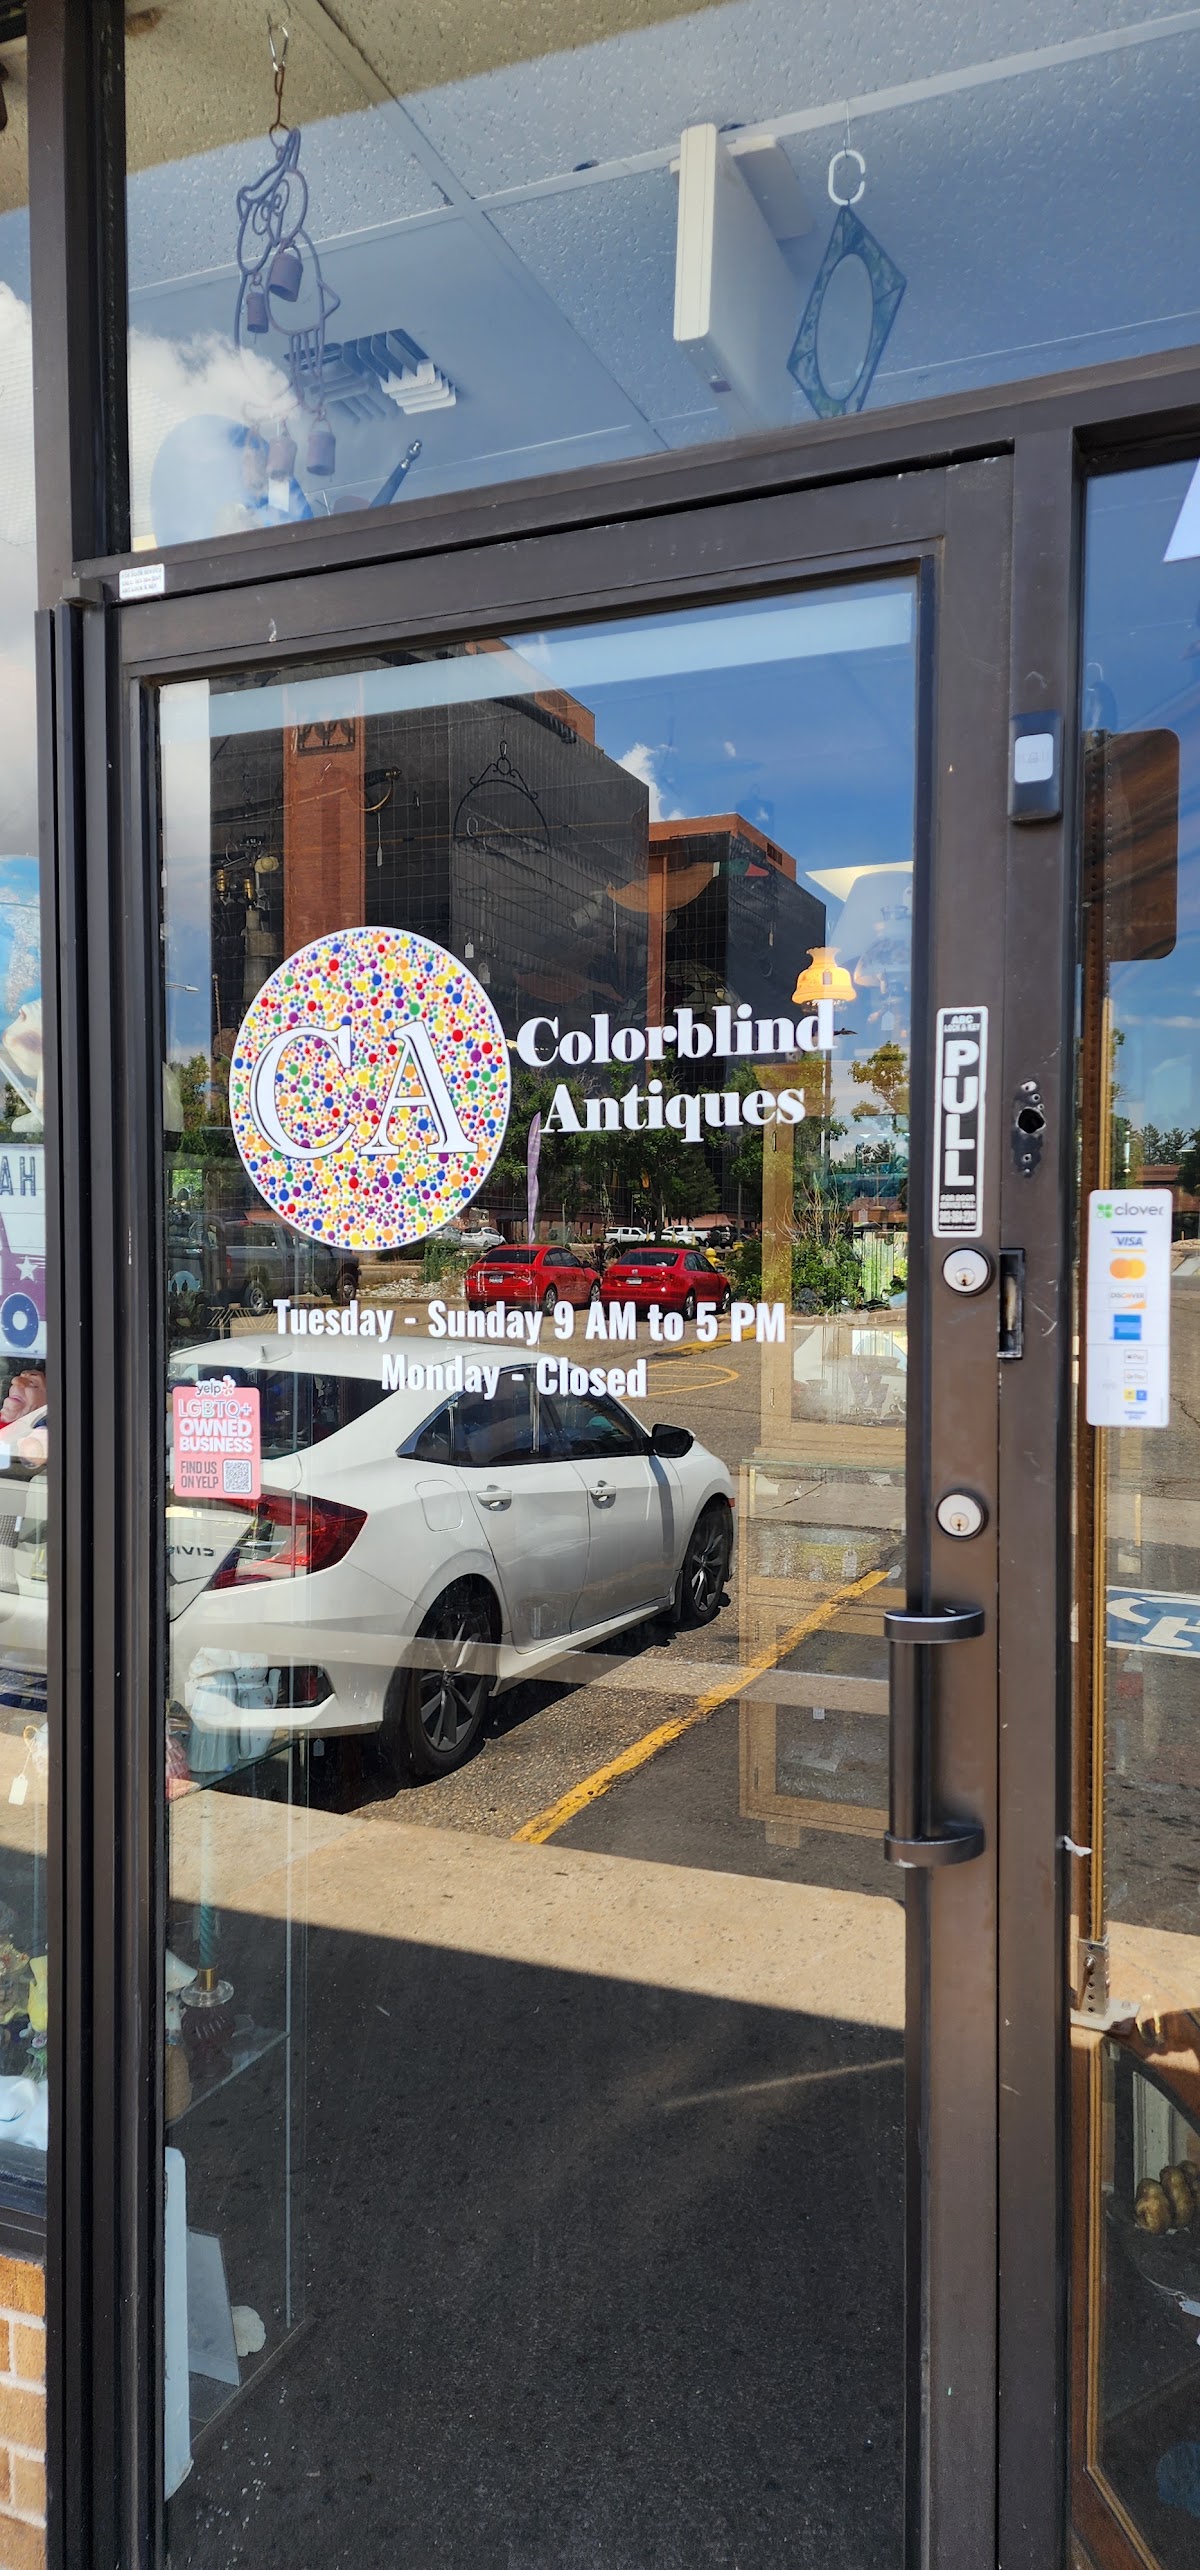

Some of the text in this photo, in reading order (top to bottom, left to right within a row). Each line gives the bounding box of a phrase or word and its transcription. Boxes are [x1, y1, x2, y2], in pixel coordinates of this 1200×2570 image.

[950, 1014, 974, 1024] ABC
[516, 998, 839, 1068] Colorblind
[250, 1020, 479, 1160] CA
[538, 1079, 806, 1143] Antiques
[942, 1039, 980, 1187] PULL
[1114, 1202, 1164, 1216] clover
[1116, 1236, 1143, 1246] VISA
[273, 1299, 786, 1346] Tuesday - Sunday 9 AM to 5 PM
[382, 1353, 647, 1401] Monday - Closed
[196, 1382, 221, 1396] yelp
[178, 1399, 252, 1419] LGBTQ+
[180, 1419, 252, 1438] OWNED
[180, 1437, 253, 1453] BUSINESS
[181, 1461, 218, 1475] FIND US
[182, 1475, 219, 1489] ON YELP
